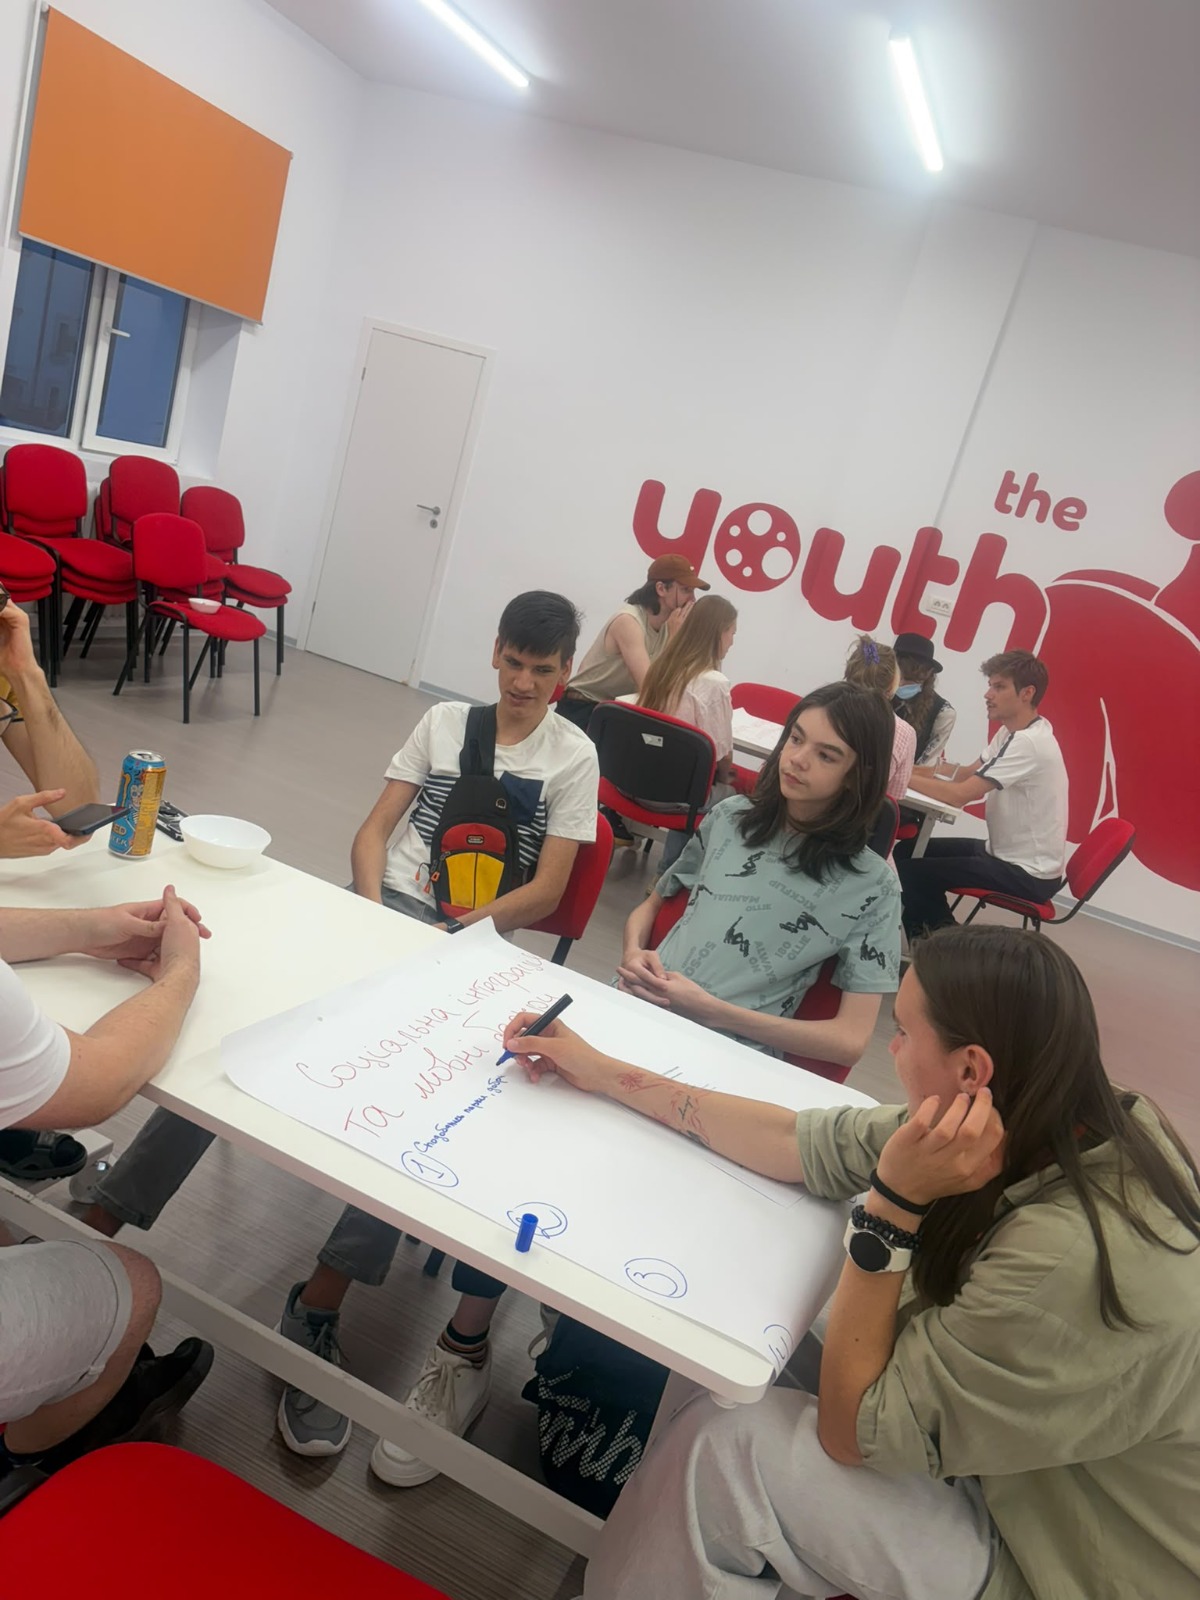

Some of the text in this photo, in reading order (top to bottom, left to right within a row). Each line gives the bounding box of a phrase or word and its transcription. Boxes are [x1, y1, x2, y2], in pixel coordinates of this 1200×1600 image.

[995, 470, 1087, 532] the
[712, 893, 761, 904] MANUAL
[769, 879, 817, 912] KICKFLIP
[754, 940, 778, 986] ALWAYS
[787, 934, 811, 961] OLLIE
[749, 956, 761, 974] ON
[296, 1006, 461, 1090] Соціальна
